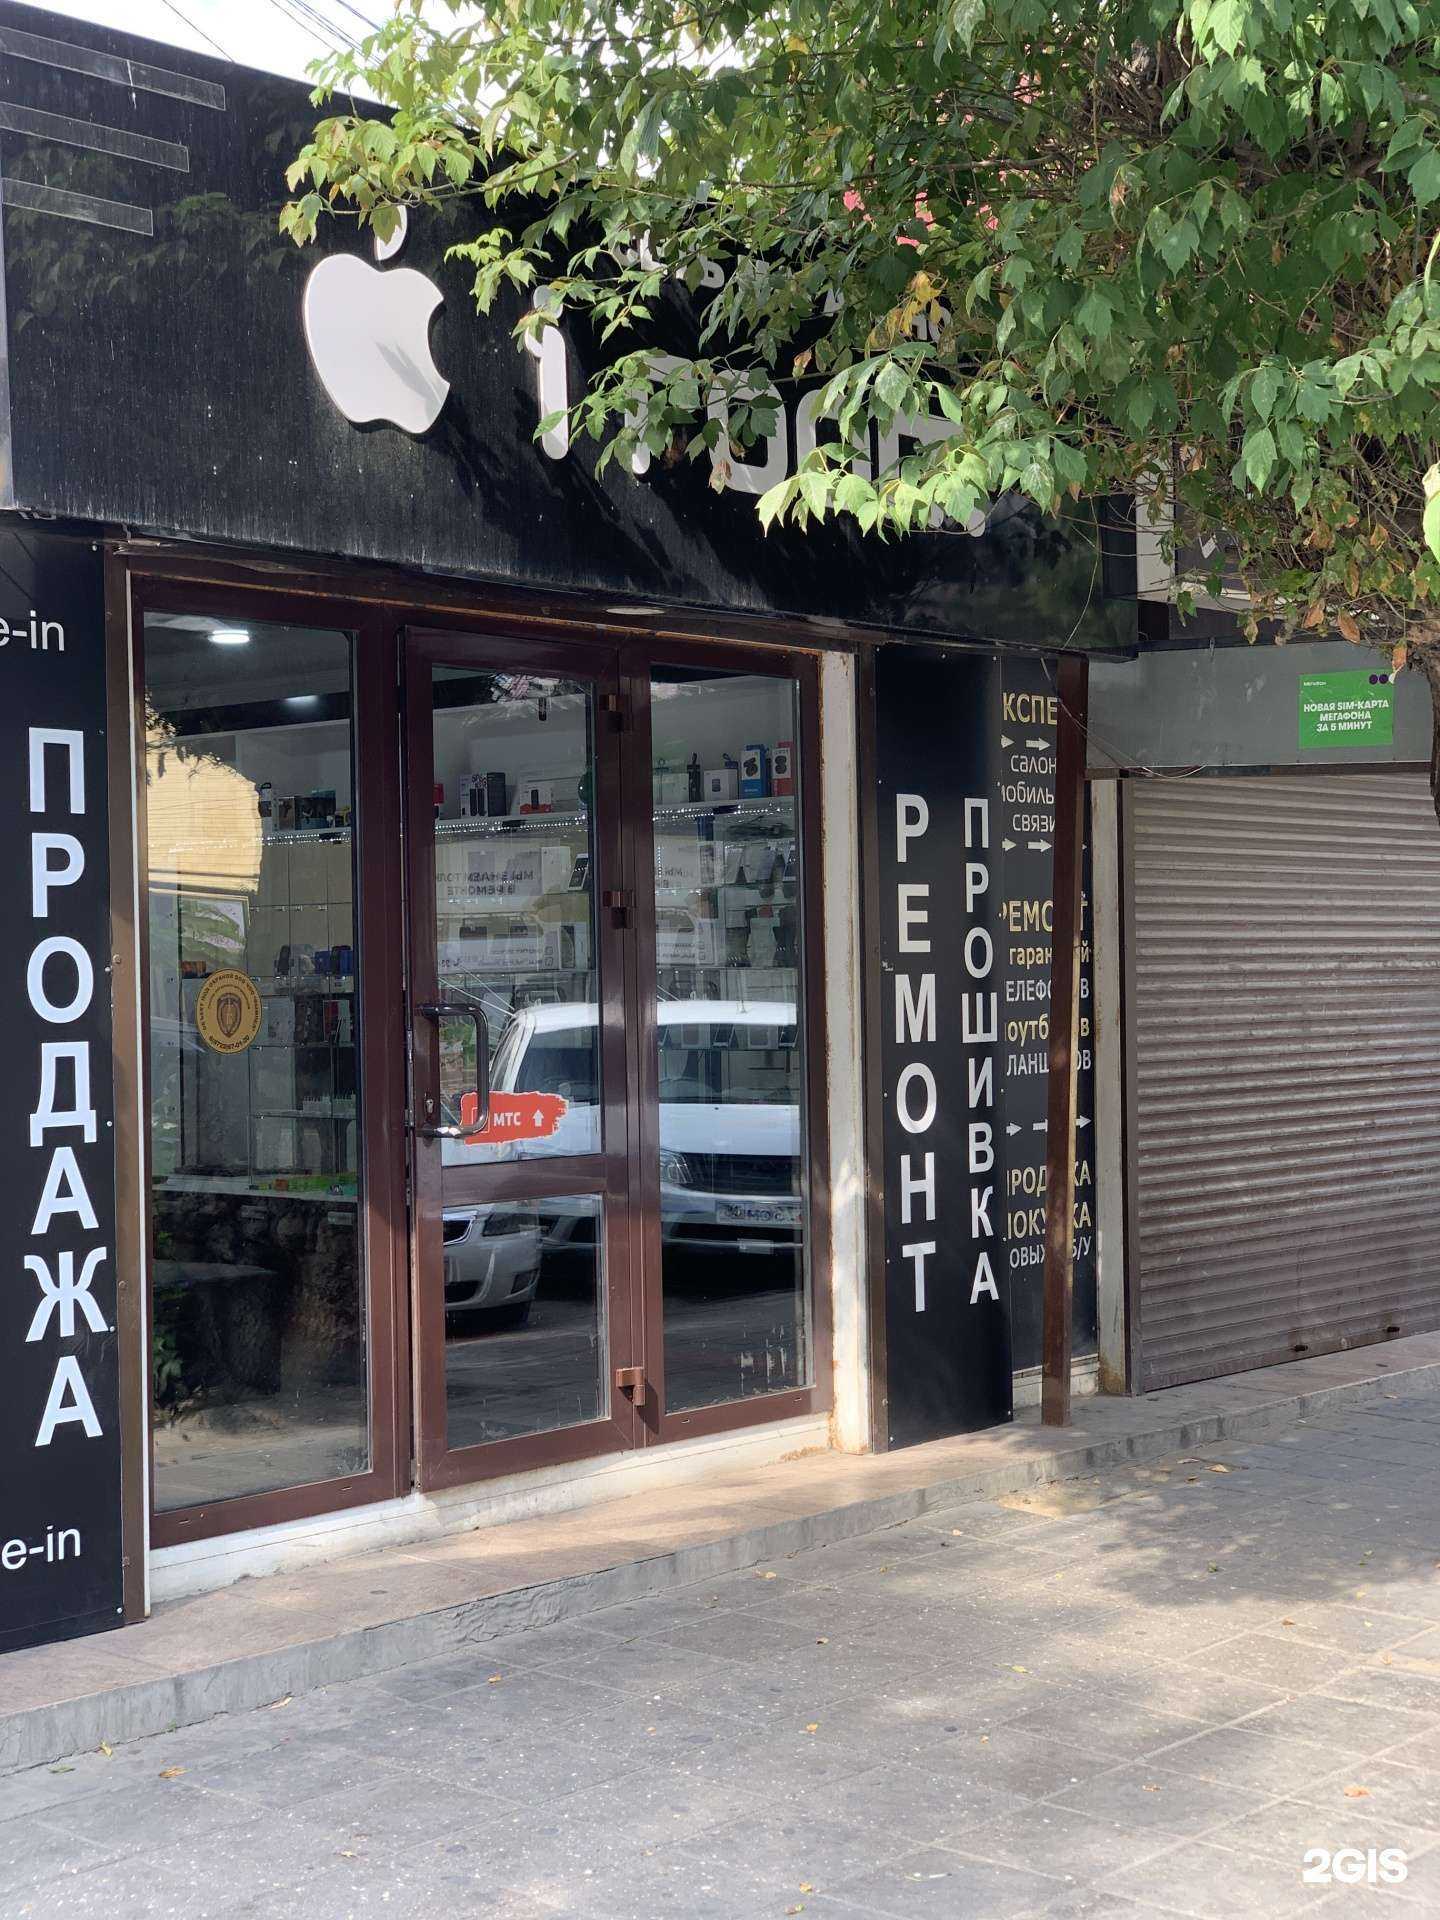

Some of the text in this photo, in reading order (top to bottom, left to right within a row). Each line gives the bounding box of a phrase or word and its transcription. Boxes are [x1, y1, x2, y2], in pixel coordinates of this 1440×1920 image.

[1304, 699, 1389, 713] НОВАЯ SIM-КАРТА
[1320, 711, 1372, 722] МЕГАФОНА
[1316, 722, 1329, 732] ЗА
[1338, 721, 1373, 731] МИНУТ
[1010, 755, 1057, 774] салон
[1002, 900, 1088, 932] ЕМОТ
[1009, 940, 1089, 969] гаранй
[1006, 978, 1089, 1002] ЕЛЕФВ
[895, 792, 937, 1313] РЕМОНТ
[961, 797, 1000, 1305] ПРОШИВКА
[26, 727, 109, 1447] ПРОДАЖА
[493, 1112, 521, 1126] МТС
[2, 1525, 81, 1570] e-in
